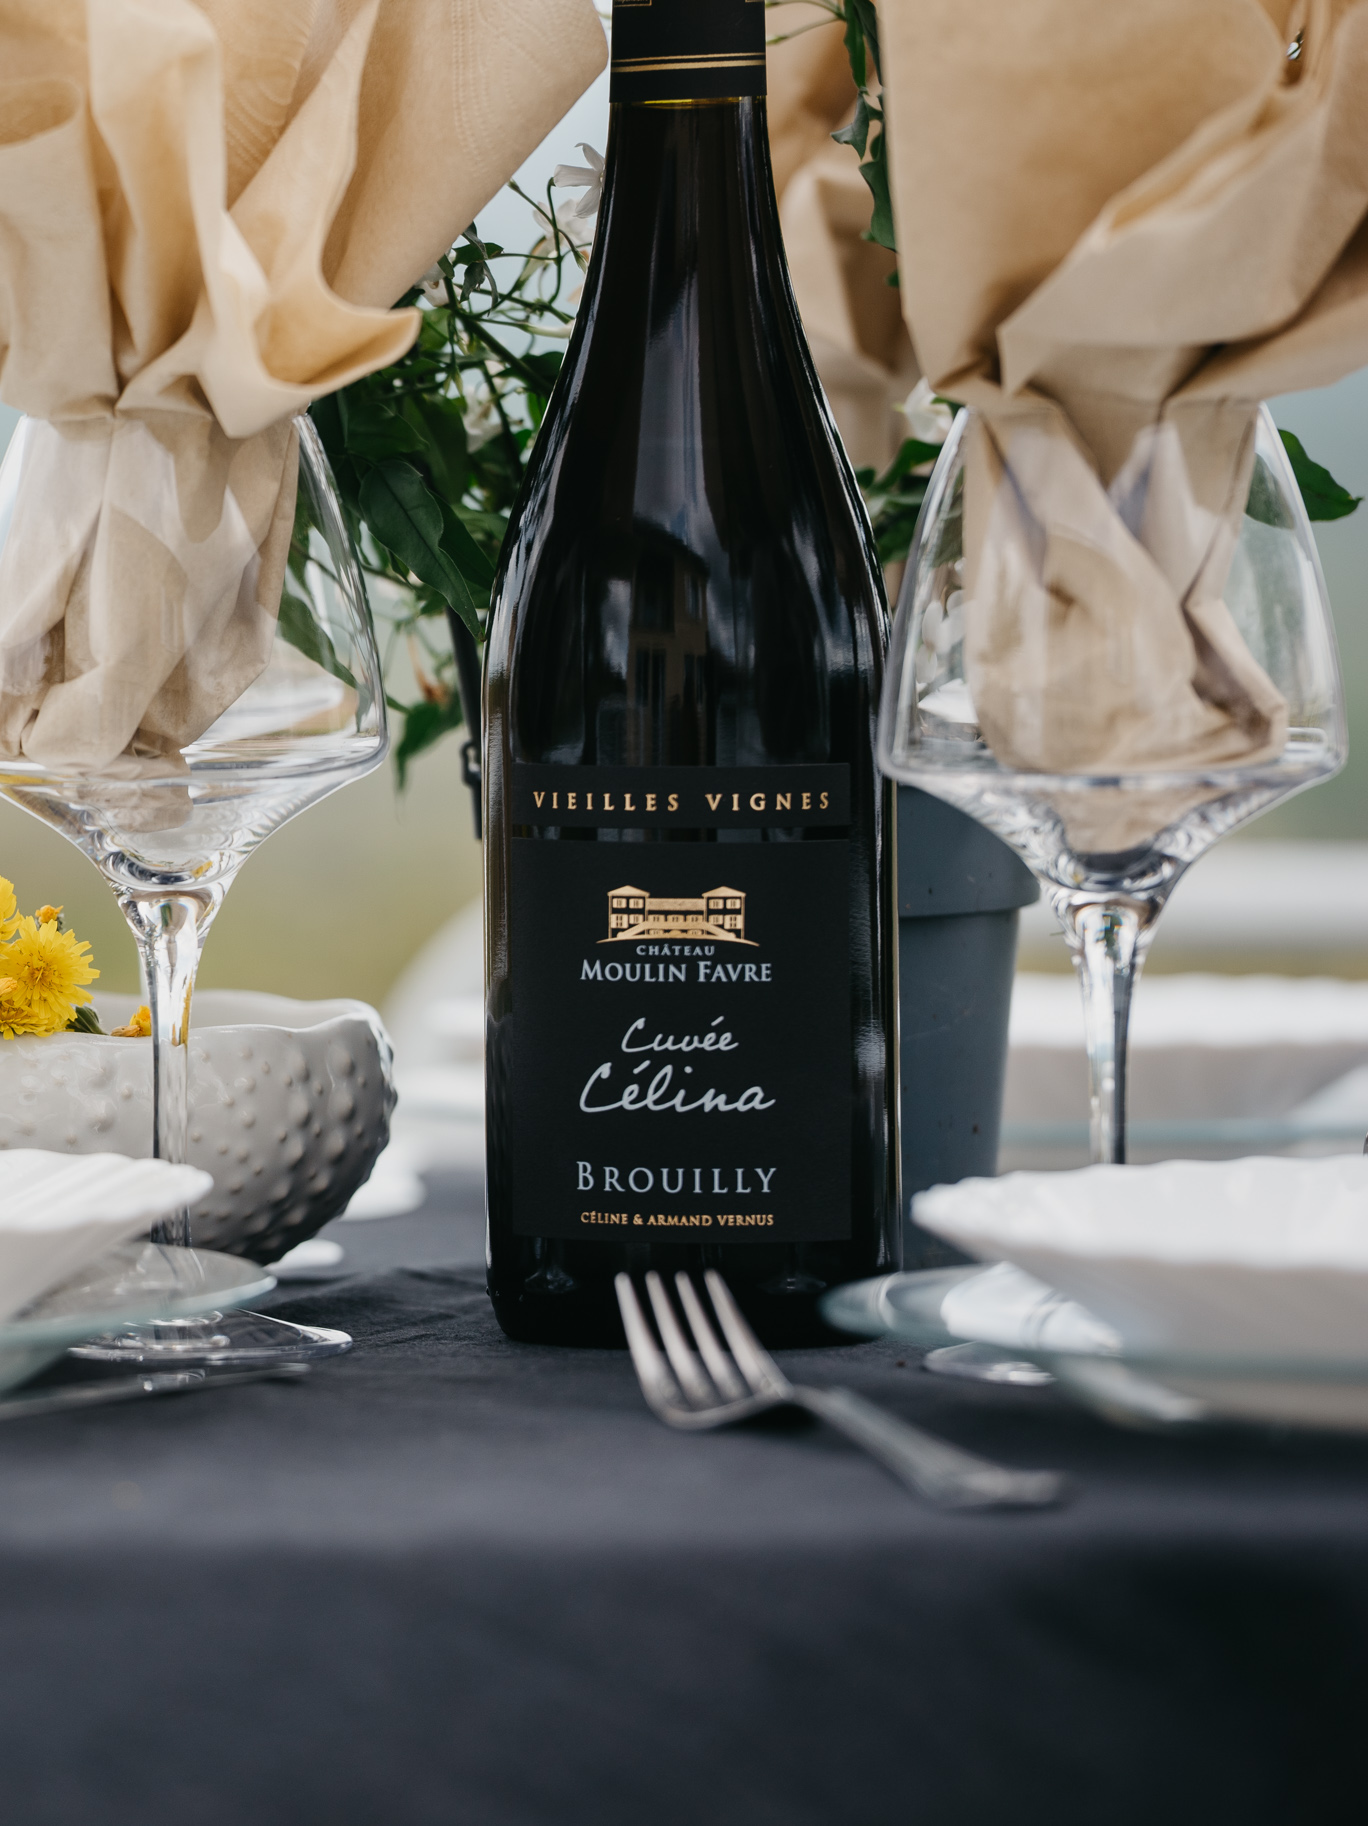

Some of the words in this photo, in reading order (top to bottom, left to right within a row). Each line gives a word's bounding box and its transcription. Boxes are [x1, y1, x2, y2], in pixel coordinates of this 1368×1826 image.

[533, 792, 679, 811] VIEILLES
[705, 792, 829, 811] VIGNES
[635, 944, 715, 956] CHÂTEAU
[580, 959, 686, 982] MOULIN
[697, 961, 772, 982] FAVRE
[621, 1016, 739, 1052] Cuvée
[580, 1060, 776, 1112] Célina
[577, 1161, 776, 1193] BROUILLY
[581, 1210, 628, 1225] CÉLINE
[633, 1214, 644, 1226] &
[647, 1214, 712, 1226] ARMAND
[717, 1214, 774, 1226] VERNUS
